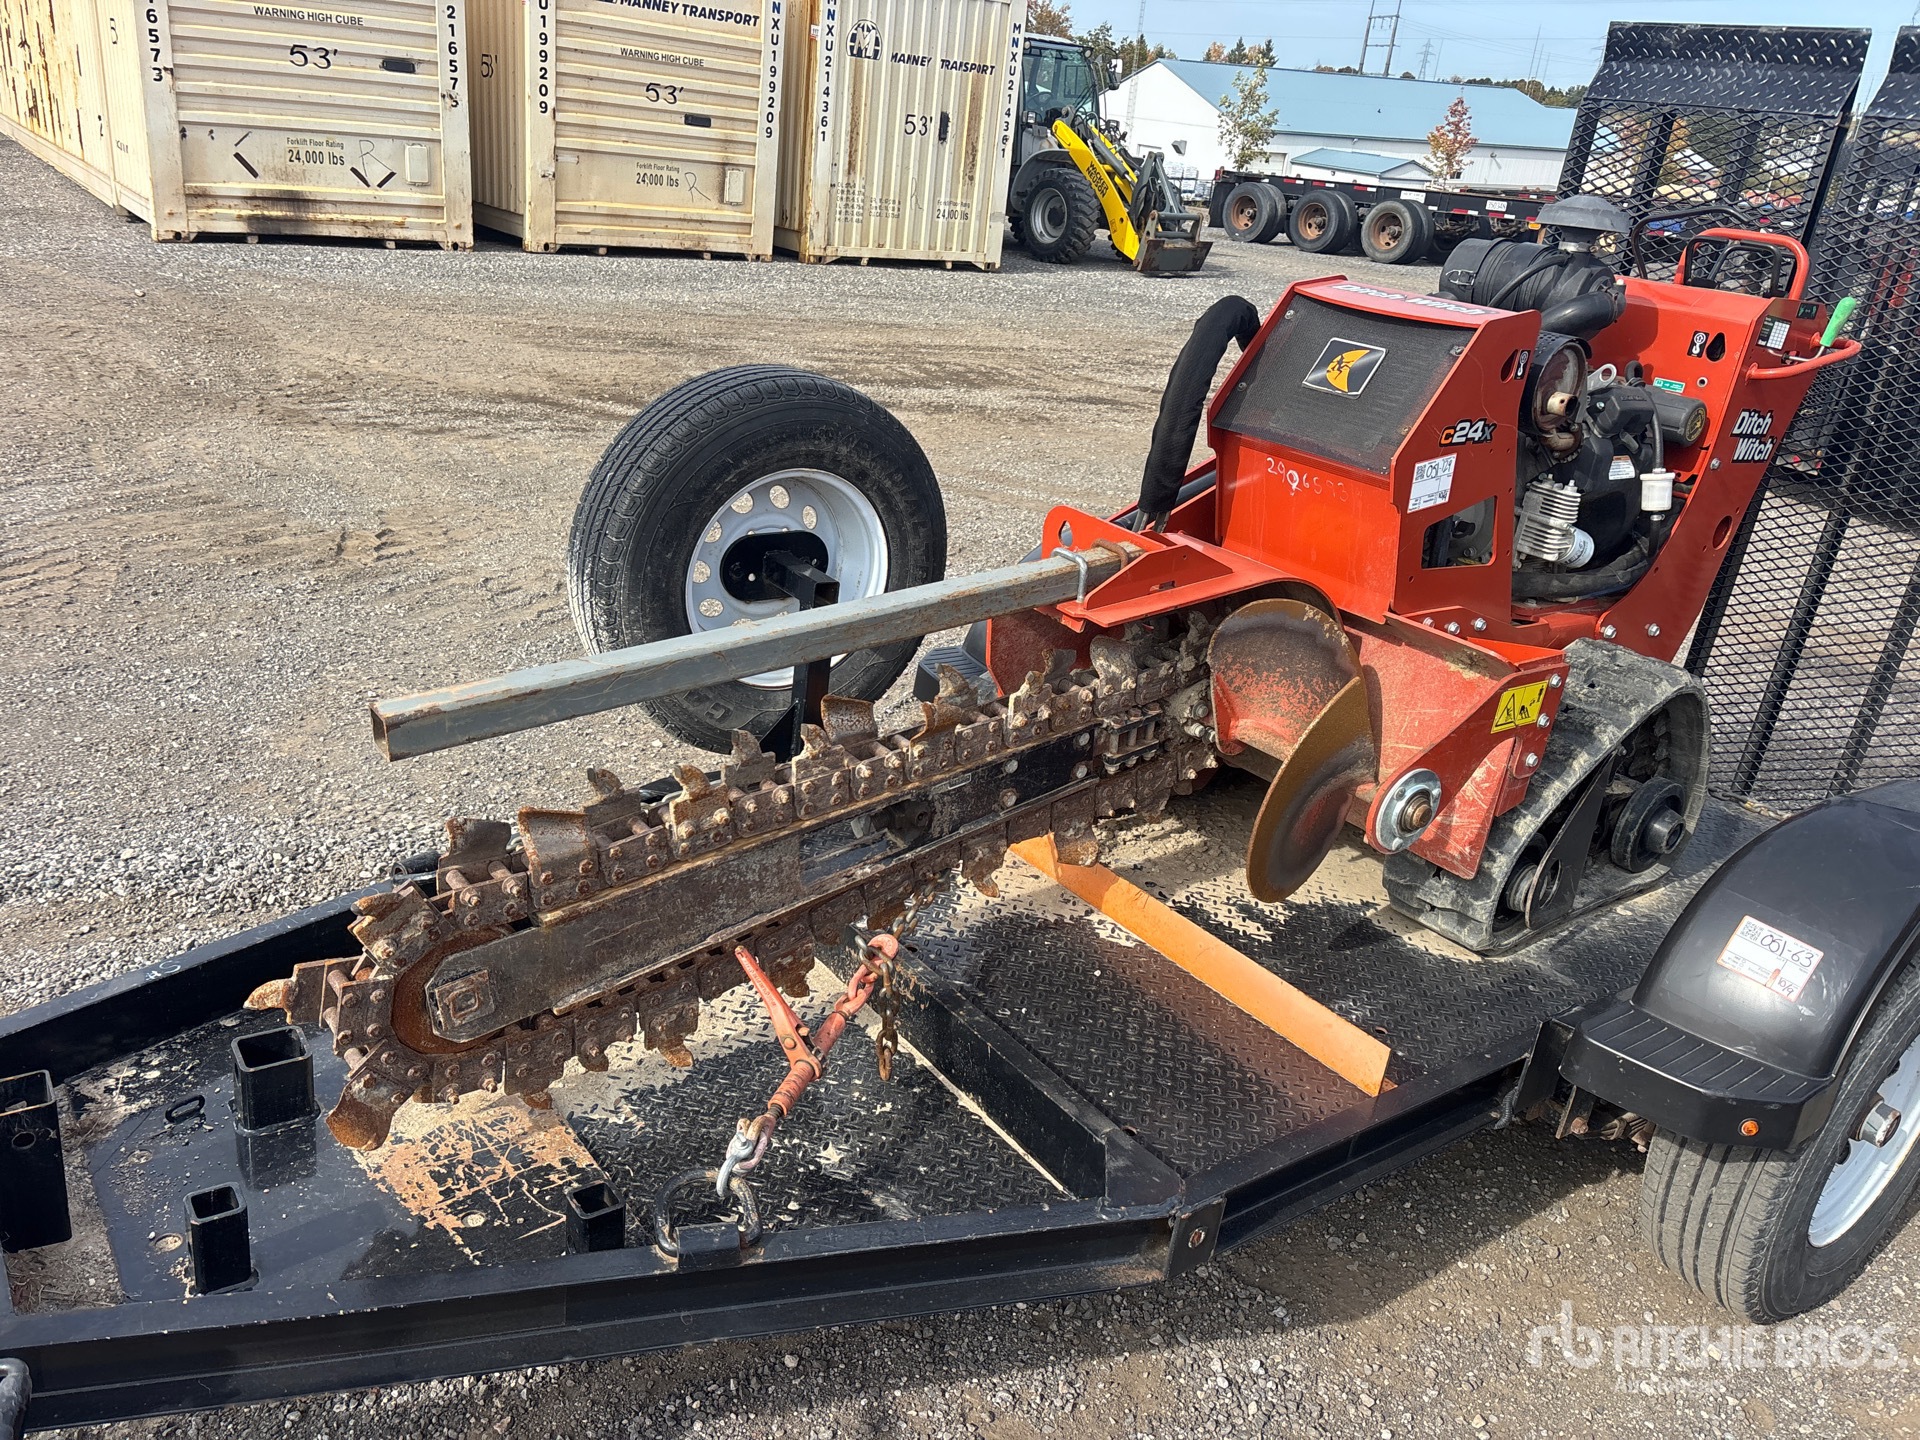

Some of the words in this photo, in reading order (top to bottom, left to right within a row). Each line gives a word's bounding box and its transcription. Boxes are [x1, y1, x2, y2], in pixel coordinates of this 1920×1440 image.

[254, 5, 305, 20] WARNING
[307, 11, 333, 23] HIGH
[335, 15, 364, 26] CUBE
[682, 4, 760, 27] TRANSPORT
[145, 0, 164, 82] 6573
[289, 43, 338, 70] 53'
[619, 47, 660, 61] WARNING
[661, 53, 681, 64] HIGH
[682, 56, 705, 67] CUBE
[890, 52, 932, 68] MANNEY
[940, 58, 996, 76] TRANSPORT
[645, 82, 685, 105] 53'
[1001, 22, 1022, 159] MNXU214361
[904, 113, 933, 136] 53'
[286, 136, 308, 147] Forklift
[309, 138, 324, 147] Floor
[325, 139, 344, 150] Rating
[288, 149, 324, 166] 24,000
[328, 151, 345, 166] lbs
[636, 161, 653, 171] Forklift
[653, 163, 665, 171] Floor
[665, 164, 680, 174] Rating
[636, 172, 664, 187] 24,000
[666, 175, 680, 188] lbs
[1085, 166, 1109, 199] NEUSON
[1089, 160, 1109, 191] WACKER
[1332, 283, 1406, 301] Ditch
[1404, 296, 1488, 316] Witch
[1732, 411, 1773, 435] Ditch
[1732, 437, 1776, 462] Witch
